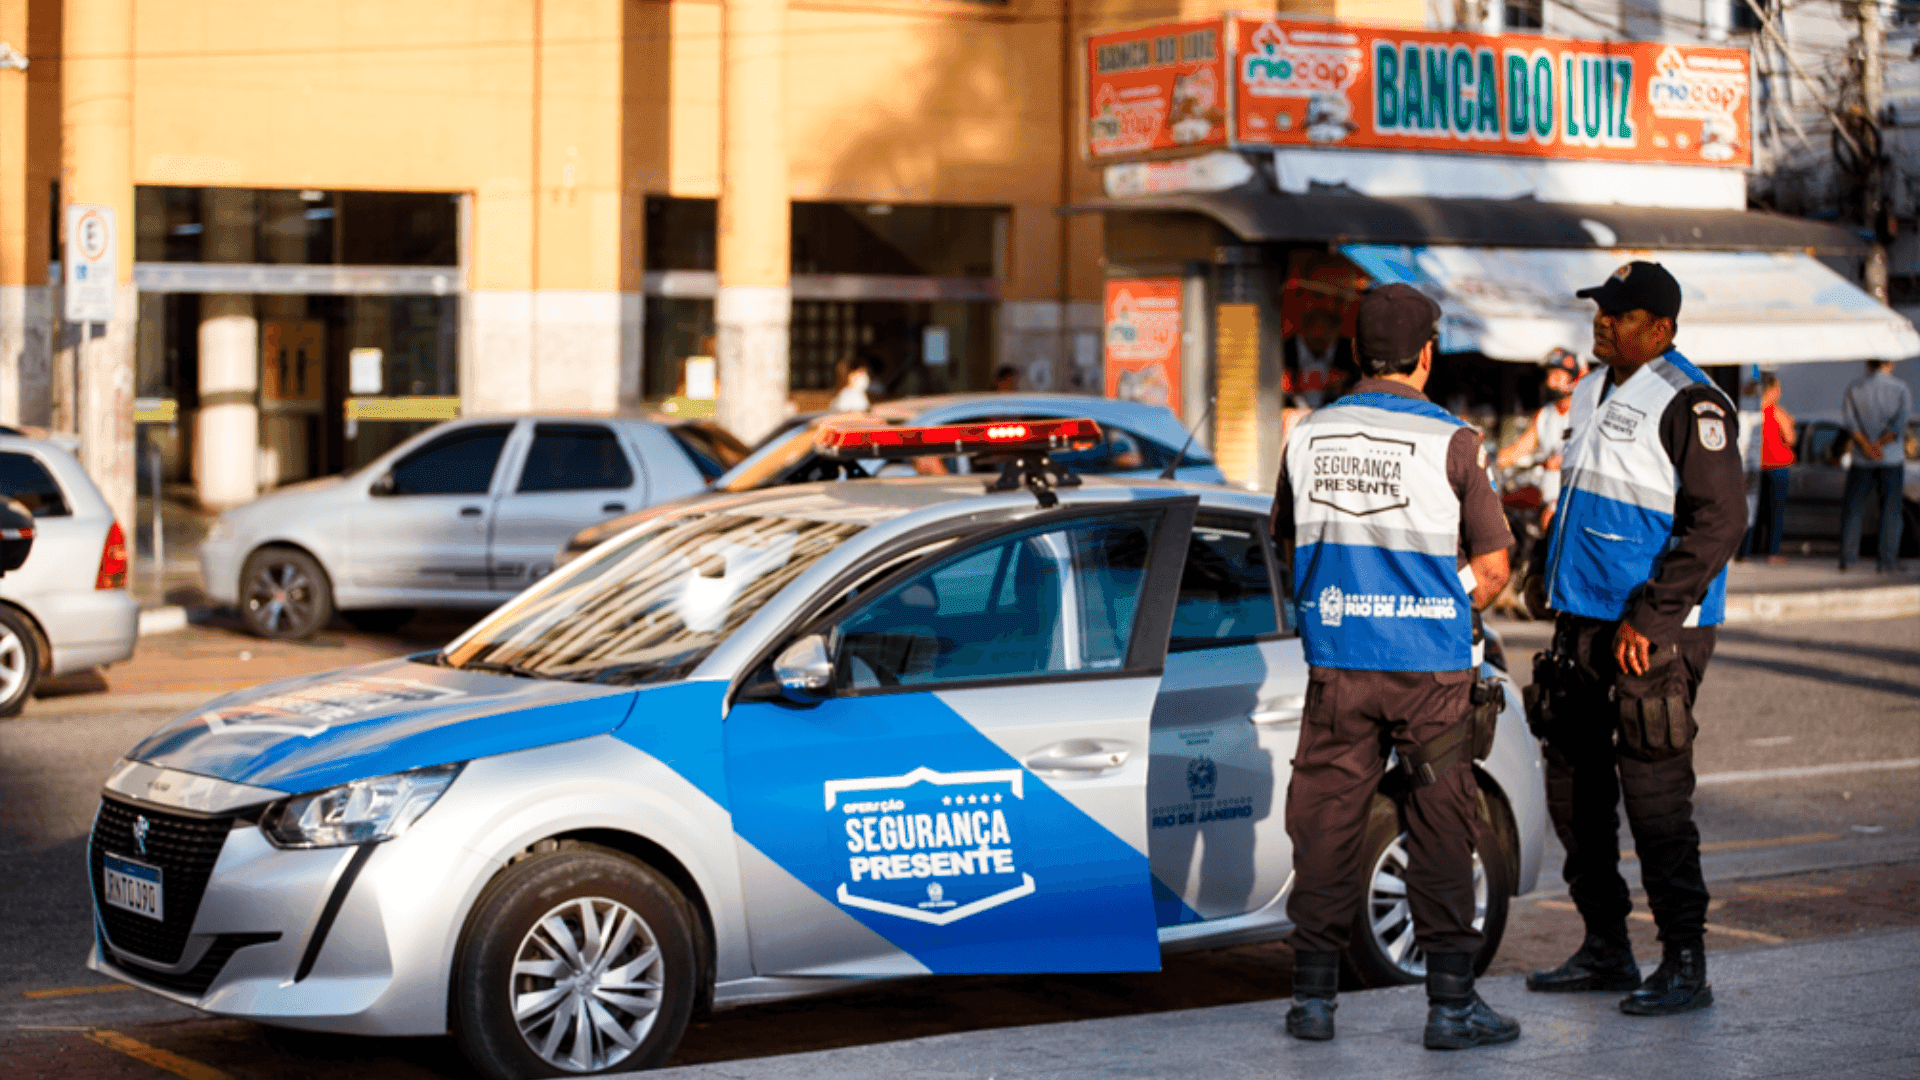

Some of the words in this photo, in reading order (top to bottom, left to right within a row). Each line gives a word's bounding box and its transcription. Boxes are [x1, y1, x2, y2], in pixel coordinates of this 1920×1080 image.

[1376, 44, 1499, 134] BANCA
[1507, 54, 1553, 136] DO
[1564, 57, 1633, 139] LUIZ
[1313, 455, 1402, 481] SEGURANÇA
[1314, 478, 1401, 498] PRESENTE
[1344, 602, 1372, 617] RIO
[1373, 602, 1395, 618] DE
[1396, 602, 1457, 619] JANEIRO
[845, 809, 1011, 853] SEGURANÇA
[850, 849, 1015, 882] PRESENTE
